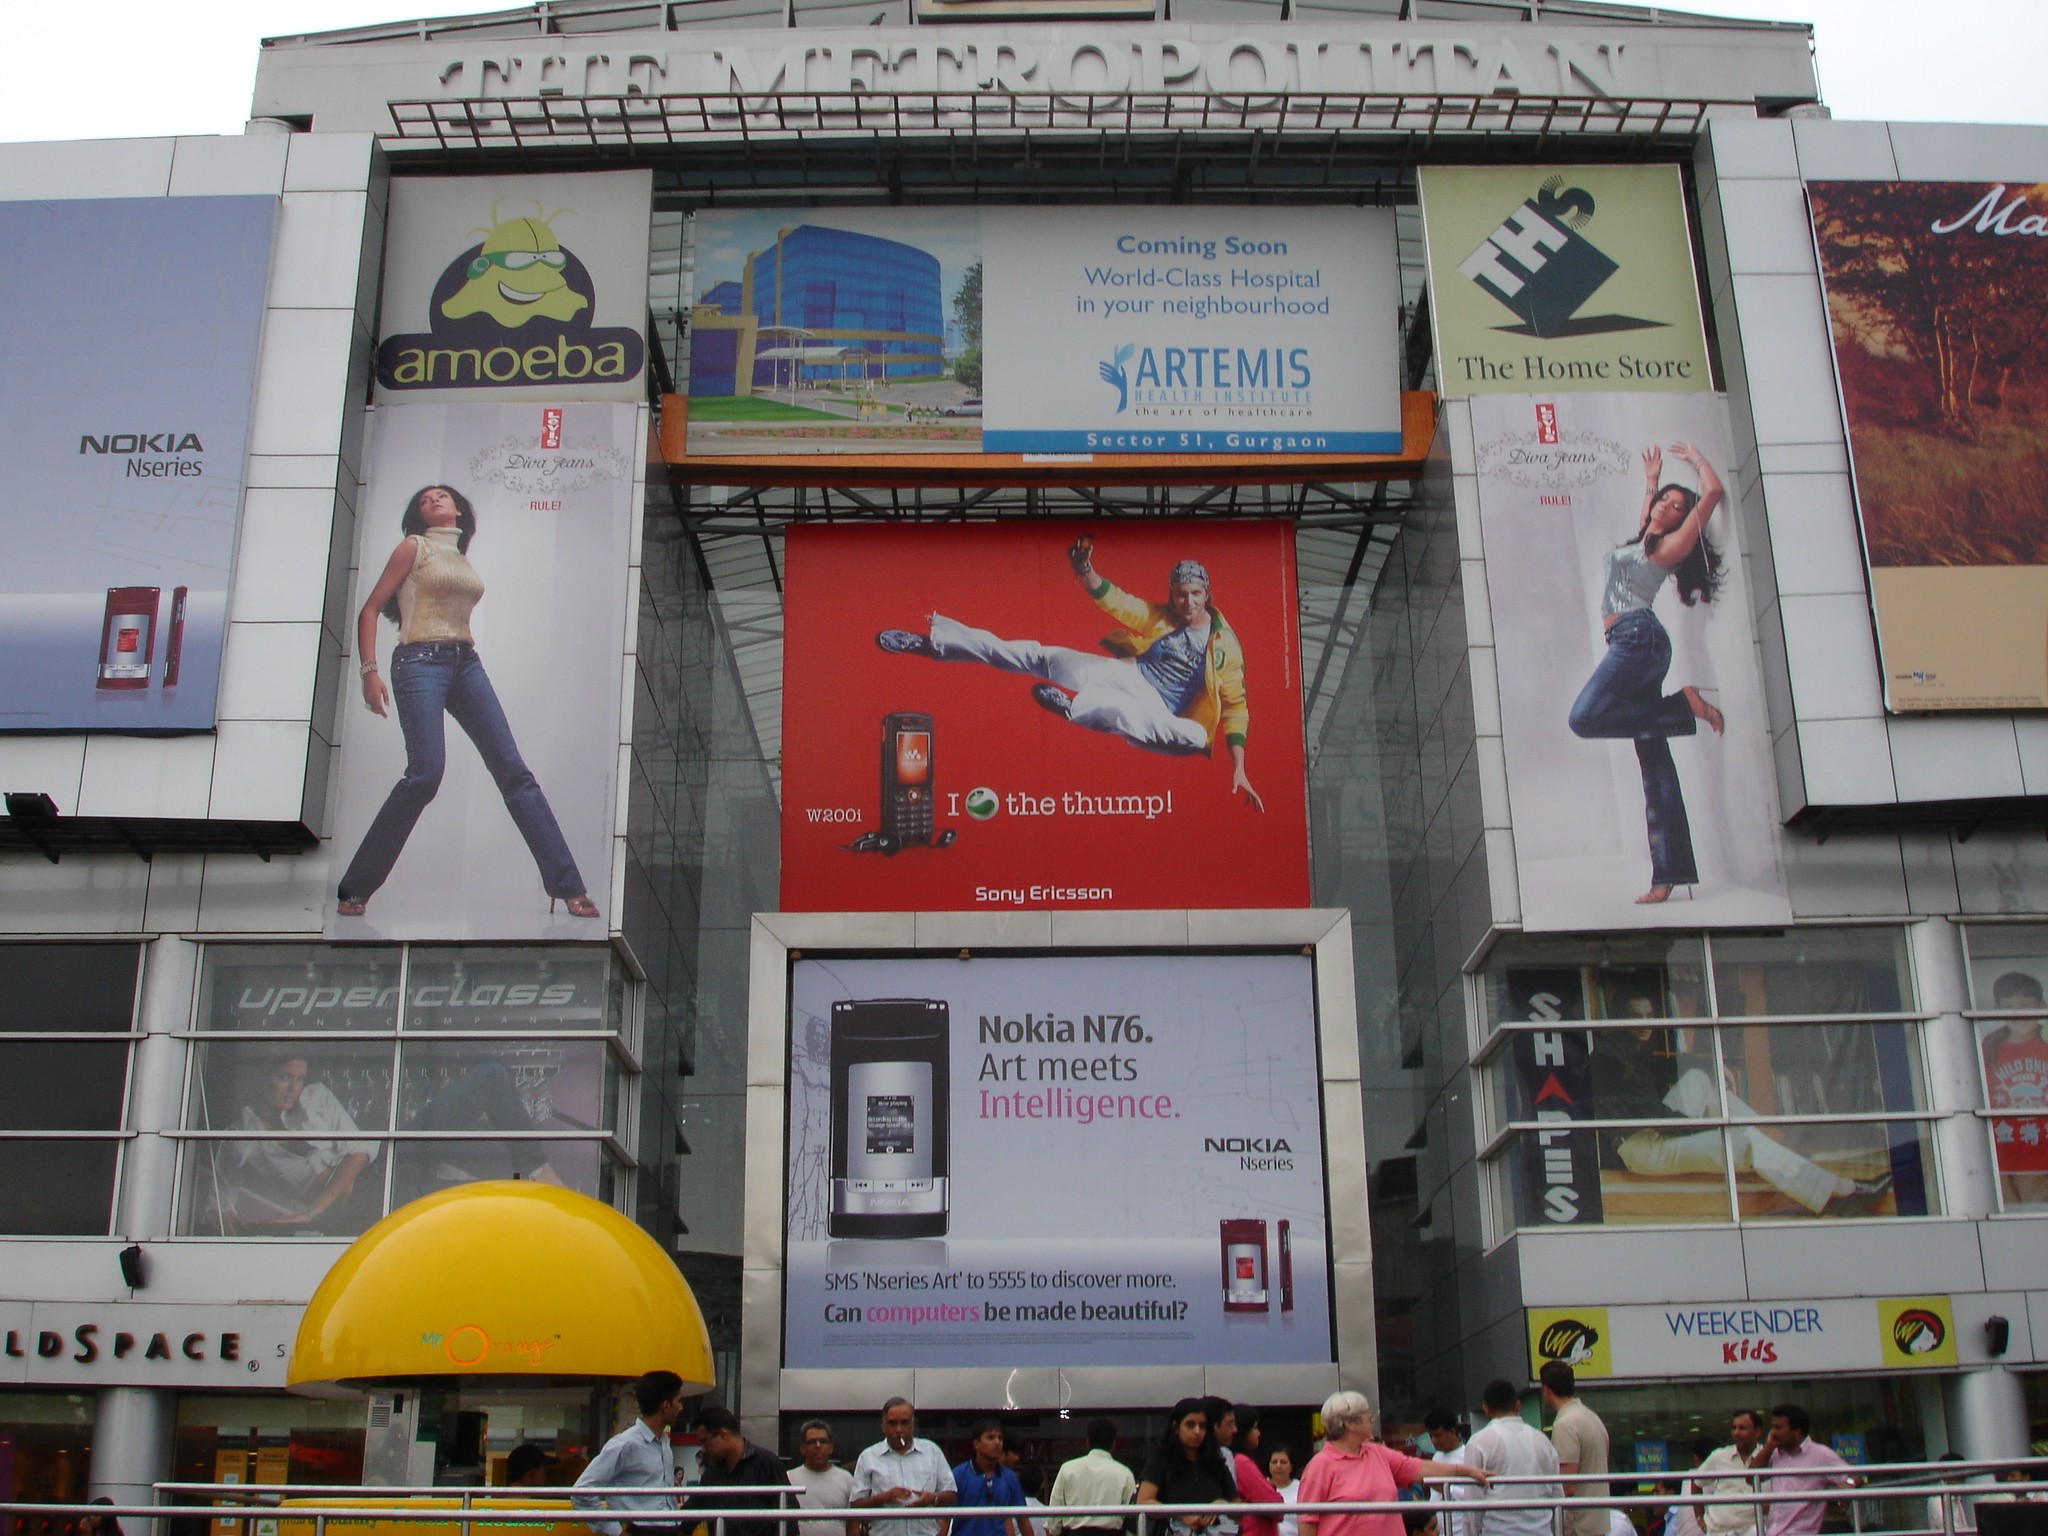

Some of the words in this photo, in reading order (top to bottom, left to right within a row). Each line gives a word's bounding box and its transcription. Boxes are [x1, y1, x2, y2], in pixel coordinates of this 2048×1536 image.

[438, 48, 667, 124] THE
[713, 40, 1625, 117] METROPOLITAN
[1116, 235, 1216, 259] Coming
[1225, 236, 1288, 255] Soon
[1085, 267, 1221, 288] World-Class
[1231, 269, 1320, 292] Hospital
[1077, 296, 1095, 313] in
[1104, 299, 1154, 318] your
[1163, 296, 1329, 319] neighbourhood
[393, 334, 625, 383] amoeba
[1134, 347, 1311, 389] ARTEMIS
[1457, 356, 1514, 381] The
[1523, 356, 1609, 381] Home
[1618, 355, 1692, 379] Store
[1135, 390, 1202, 402] HEALTH
[1215, 390, 1311, 403] INSTITUTE
[1135, 407, 1159, 416] the
[1170, 408, 1193, 416] art
[1203, 407, 1218, 417] of
[1228, 407, 1312, 417] healthcare
[80, 433, 204, 455] NOKIA
[1086, 433, 1166, 447] Sector
[1227, 433, 1327, 451] Gurgaon
[126, 458, 203, 478] Nseries
[504, 453, 547, 470] Diva
[543, 454, 595, 477] Jeans
[1507, 449, 1549, 465] Diva
[1547, 450, 1597, 471] Jeans
[530, 500, 562, 511] RULE!
[1539, 496, 1571, 507] RULE!
[805, 808, 863, 824] W200i
[947, 793, 960, 817] I
[1006, 792, 1056, 815] the
[1062, 790, 1173, 820] thump!
[975, 886, 1025, 904] Sony
[1030, 885, 1113, 900] Ericsson
[238, 979, 577, 1016] upperclass
[236, 1017, 351, 1029] JEANS
[386, 1016, 565, 1026] COMPANY
[979, 1013, 1076, 1043] Nokia
[1083, 1014, 1154, 1043] N76.
[978, 1053, 1027, 1082] Art
[1037, 1055, 1138, 1082] meets
[979, 1088, 1182, 1124] Intelligence.
[1204, 1138, 1292, 1153] NOKIA
[1240, 1156, 1294, 1171] Nseries
[869, 1199, 910, 1207] NOKIA
[825, 1272, 858, 1291] SMS
[862, 1271, 929, 1291] 'Nseries
[932, 1271, 963, 1290] Art'
[967, 1274, 985, 1290] to
[988, 1271, 1026, 1289] 5555
[1031, 1273, 1048, 1289] to
[1052, 1270, 1122, 1289] discover
[1126, 1275, 1177, 1289] more.
[824, 1303, 862, 1323] Can
[866, 1304, 980, 1326] computers
[984, 1301, 1010, 1322] be
[1015, 1301, 1076, 1322] made
[1081, 1300, 1189, 1321] beautiful?
[1665, 1308, 1823, 1337] WEEKENDER
[1723, 1339, 1778, 1364] Kids
